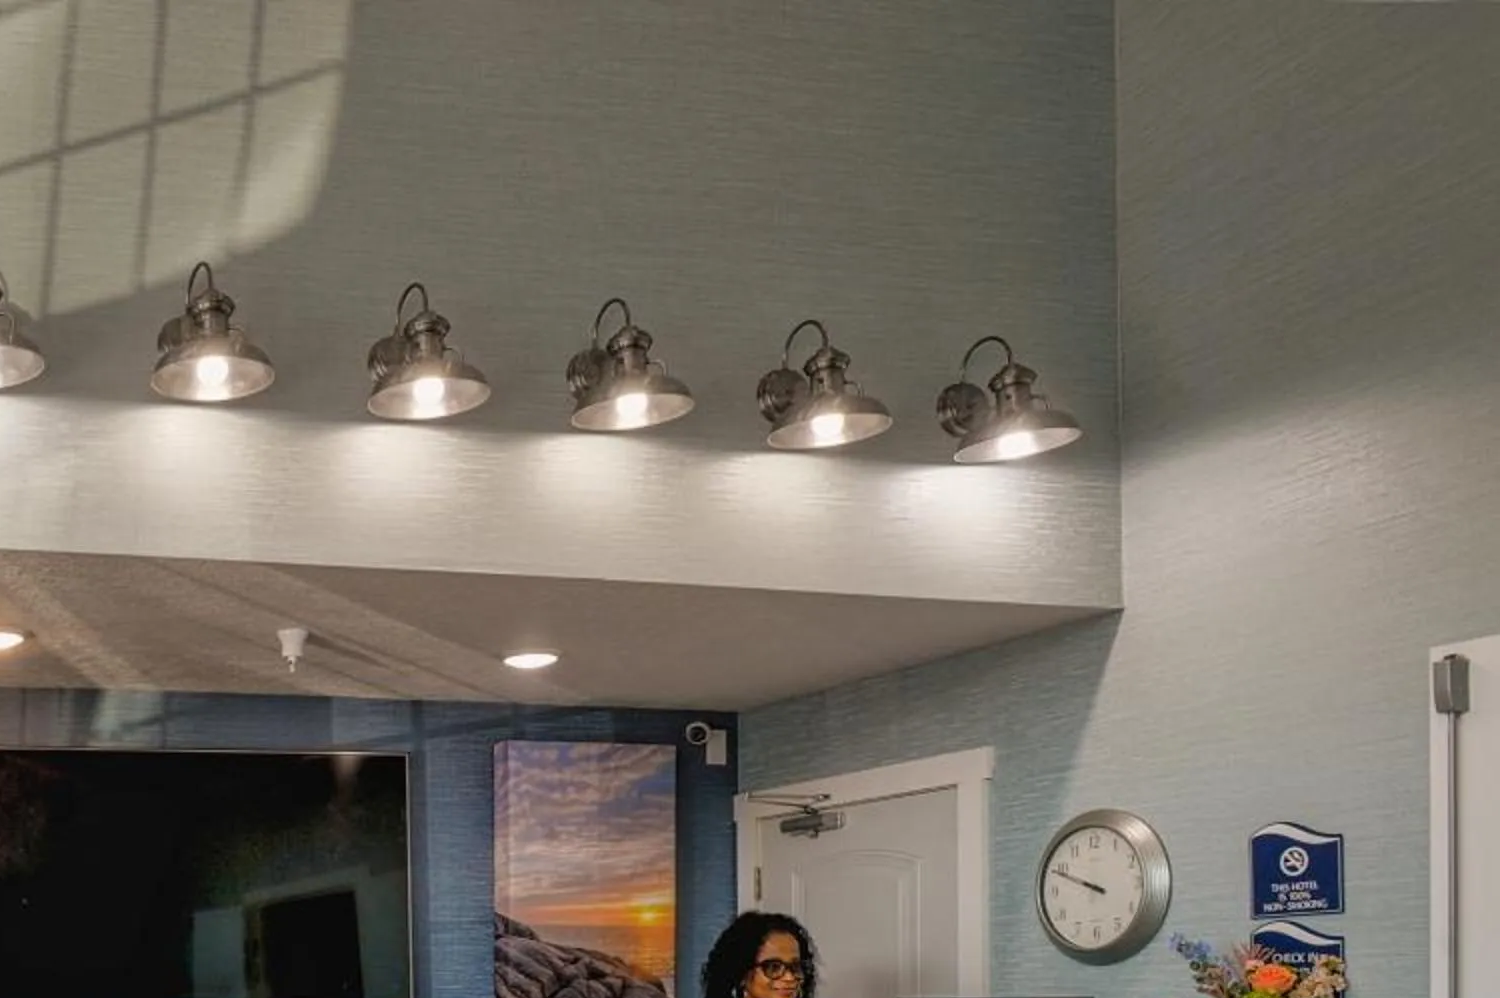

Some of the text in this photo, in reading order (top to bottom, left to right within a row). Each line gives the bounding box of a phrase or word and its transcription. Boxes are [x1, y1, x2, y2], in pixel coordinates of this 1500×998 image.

[1089, 835, 1101, 849] 12
[1271, 881, 1319, 893] THIS HOTEL
[1289, 891, 1312, 901] 100%
[1263, 898, 1329, 912] NON-SMOKING
